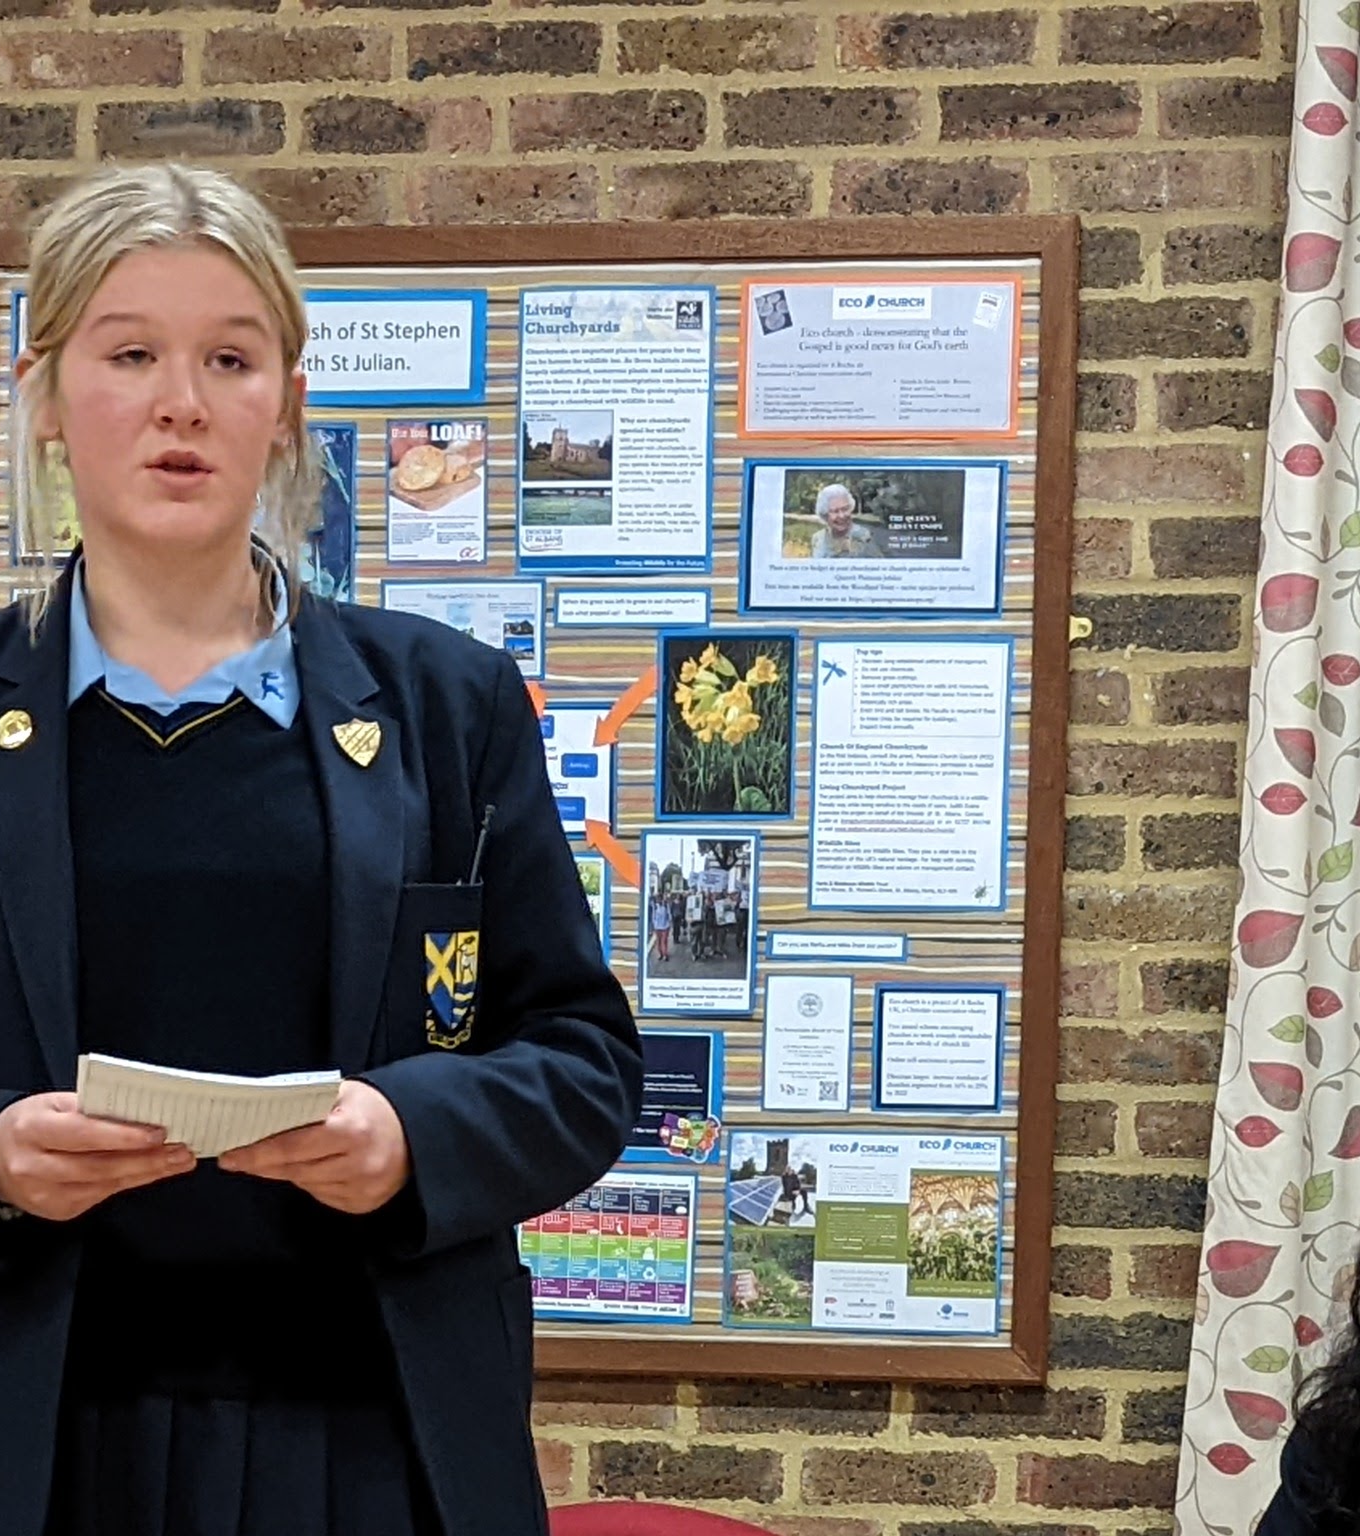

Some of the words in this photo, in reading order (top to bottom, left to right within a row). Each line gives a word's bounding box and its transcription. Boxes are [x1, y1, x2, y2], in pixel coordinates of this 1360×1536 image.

[839, 298, 862, 307] ECO
[877, 298, 925, 307] CHURCH
[525, 303, 572, 317] Living
[337, 322, 357, 340] of
[361, 323, 379, 339] St
[384, 321, 460, 342] Stephen
[525, 322, 620, 336] Churchyards
[800, 328, 821, 337] Eco
[822, 328, 854, 337] church
[863, 328, 929, 338] demonstrating
[932, 328, 950, 337] that
[953, 328, 968, 337] the
[799, 341, 833, 353] Gospel
[844, 341, 869, 352] good
[872, 343, 894, 351] news
[898, 341, 912, 351] for
[945, 341, 969, 351] earth
[331, 355, 348, 371] St
[353, 353, 411, 371] Julian.
[431, 424, 482, 441] LOAF!
[829, 1144, 848, 1153] ECO
[860, 1145, 899, 1154] CHURCH
[919, 1140, 940, 1149] ECO
[953, 1141, 996, 1150] CHURCH
